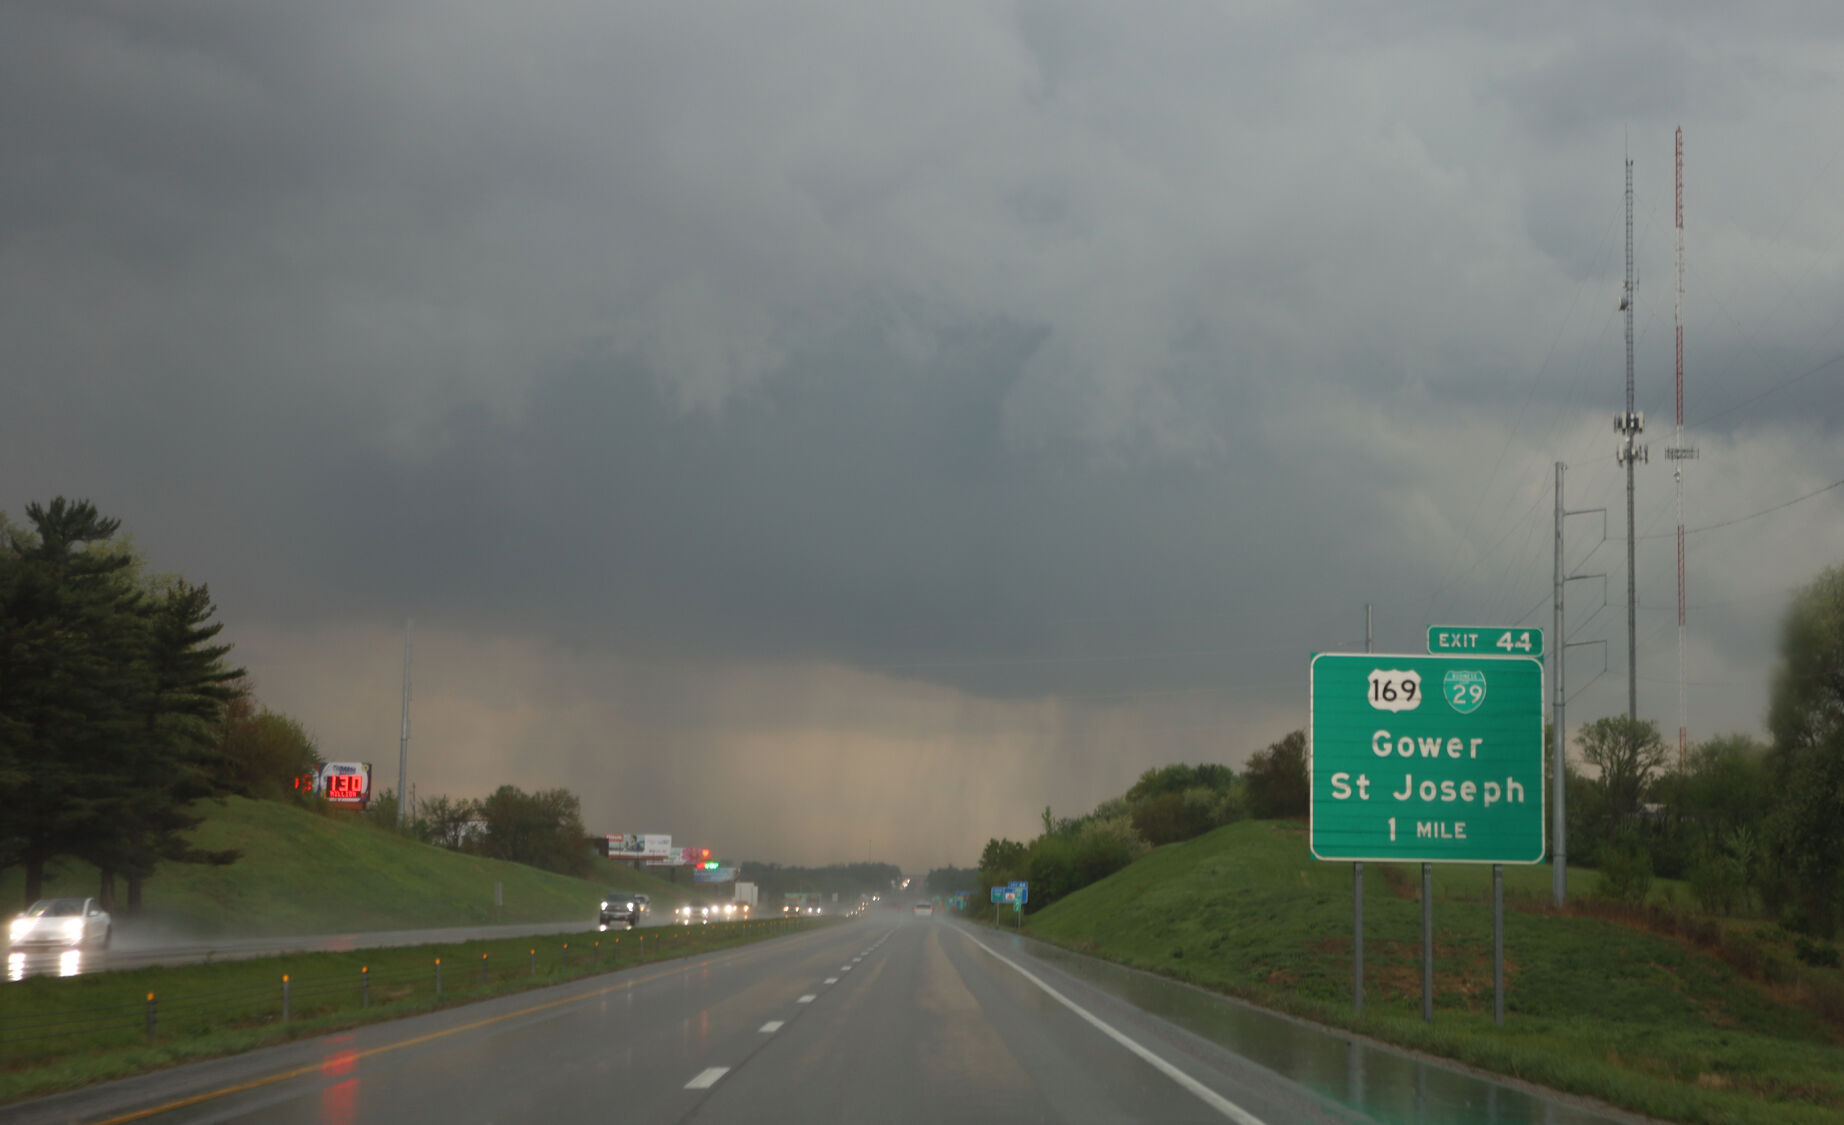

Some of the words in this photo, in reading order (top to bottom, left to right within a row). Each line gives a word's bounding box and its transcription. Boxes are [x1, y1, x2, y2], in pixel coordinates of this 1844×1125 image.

[1439, 633, 1478, 648] EXIT
[1496, 632, 1532, 651] 44
[1372, 679, 1416, 702] 169
[1453, 685, 1483, 704] 29
[1372, 730, 1483, 759] Gower
[1331, 772, 1370, 800] St
[1393, 773, 1525, 808] Joseph
[1388, 817, 1396, 842] 1
[1417, 821, 1467, 839] MILE
